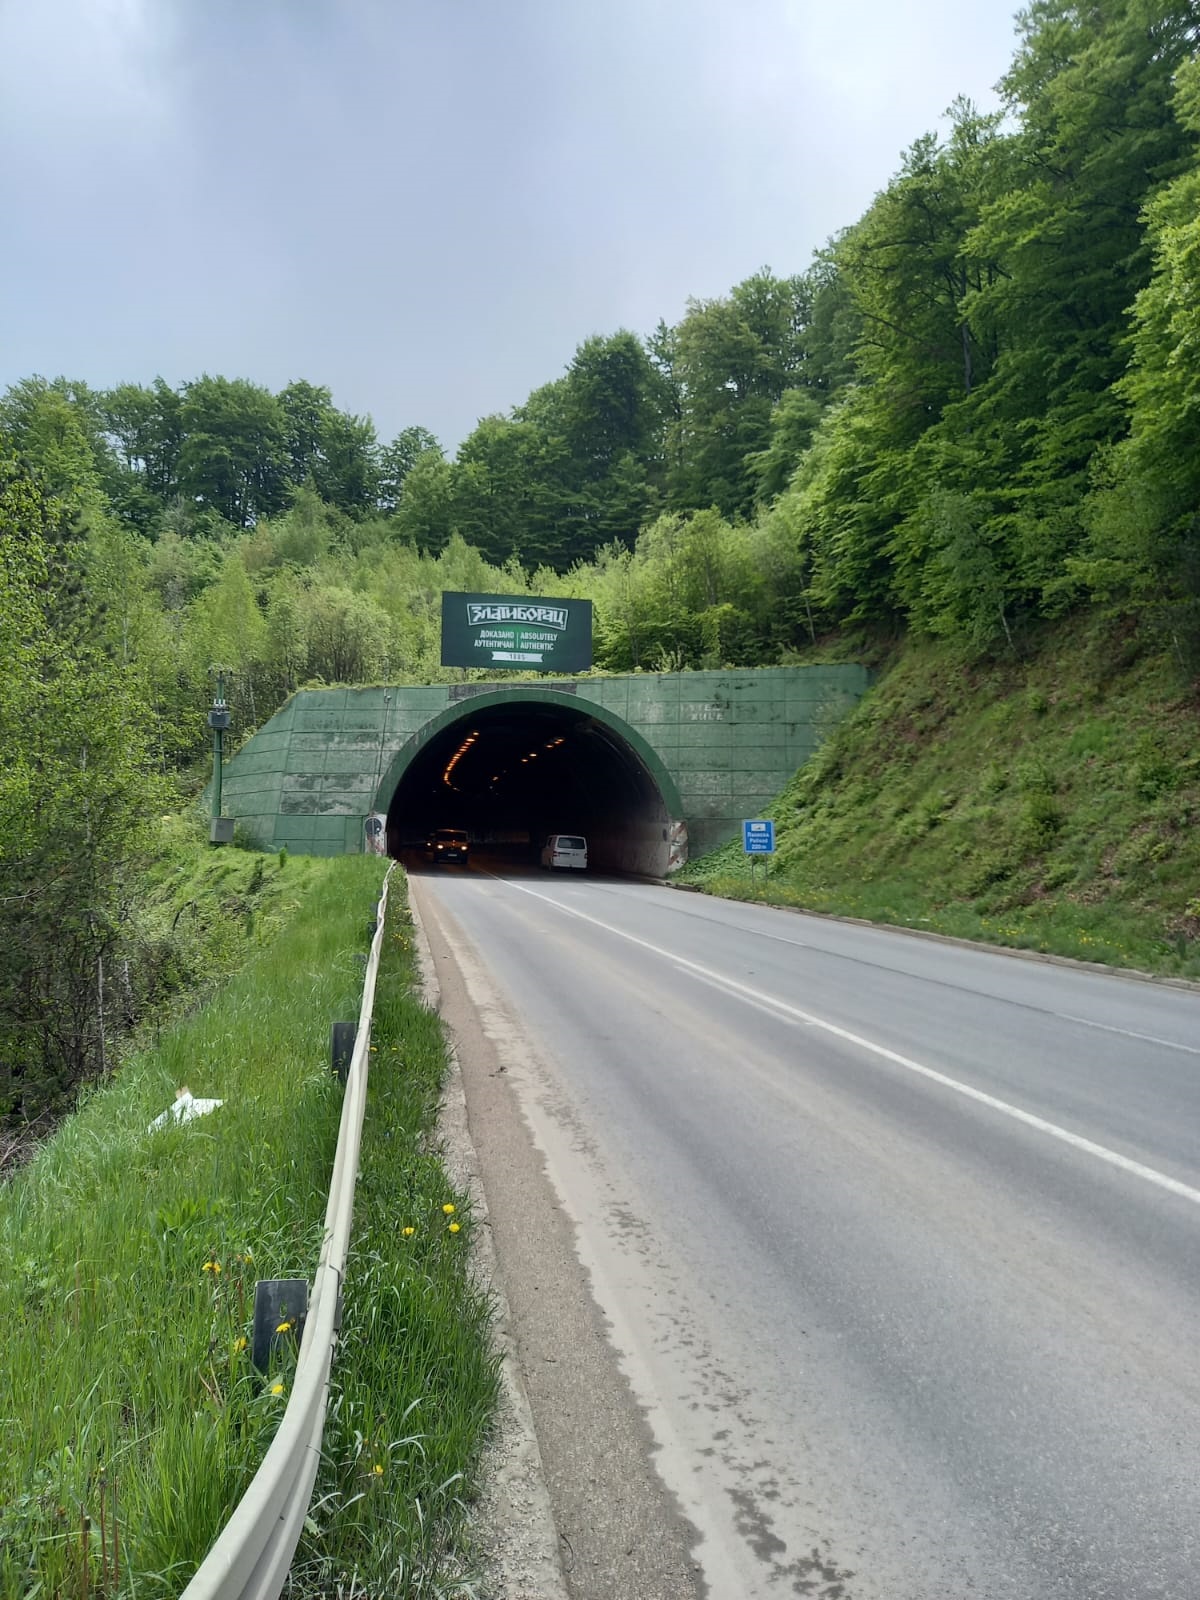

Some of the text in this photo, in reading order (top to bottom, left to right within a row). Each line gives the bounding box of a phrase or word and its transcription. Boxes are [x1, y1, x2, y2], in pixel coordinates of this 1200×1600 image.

[479, 630, 515, 639] ДОКАЗАНО
[520, 631, 558, 641] ABSOLUTELY
[474, 639, 515, 649] АУТЕНТИЧАН
[520, 642, 554, 651] AUTHENTIC
